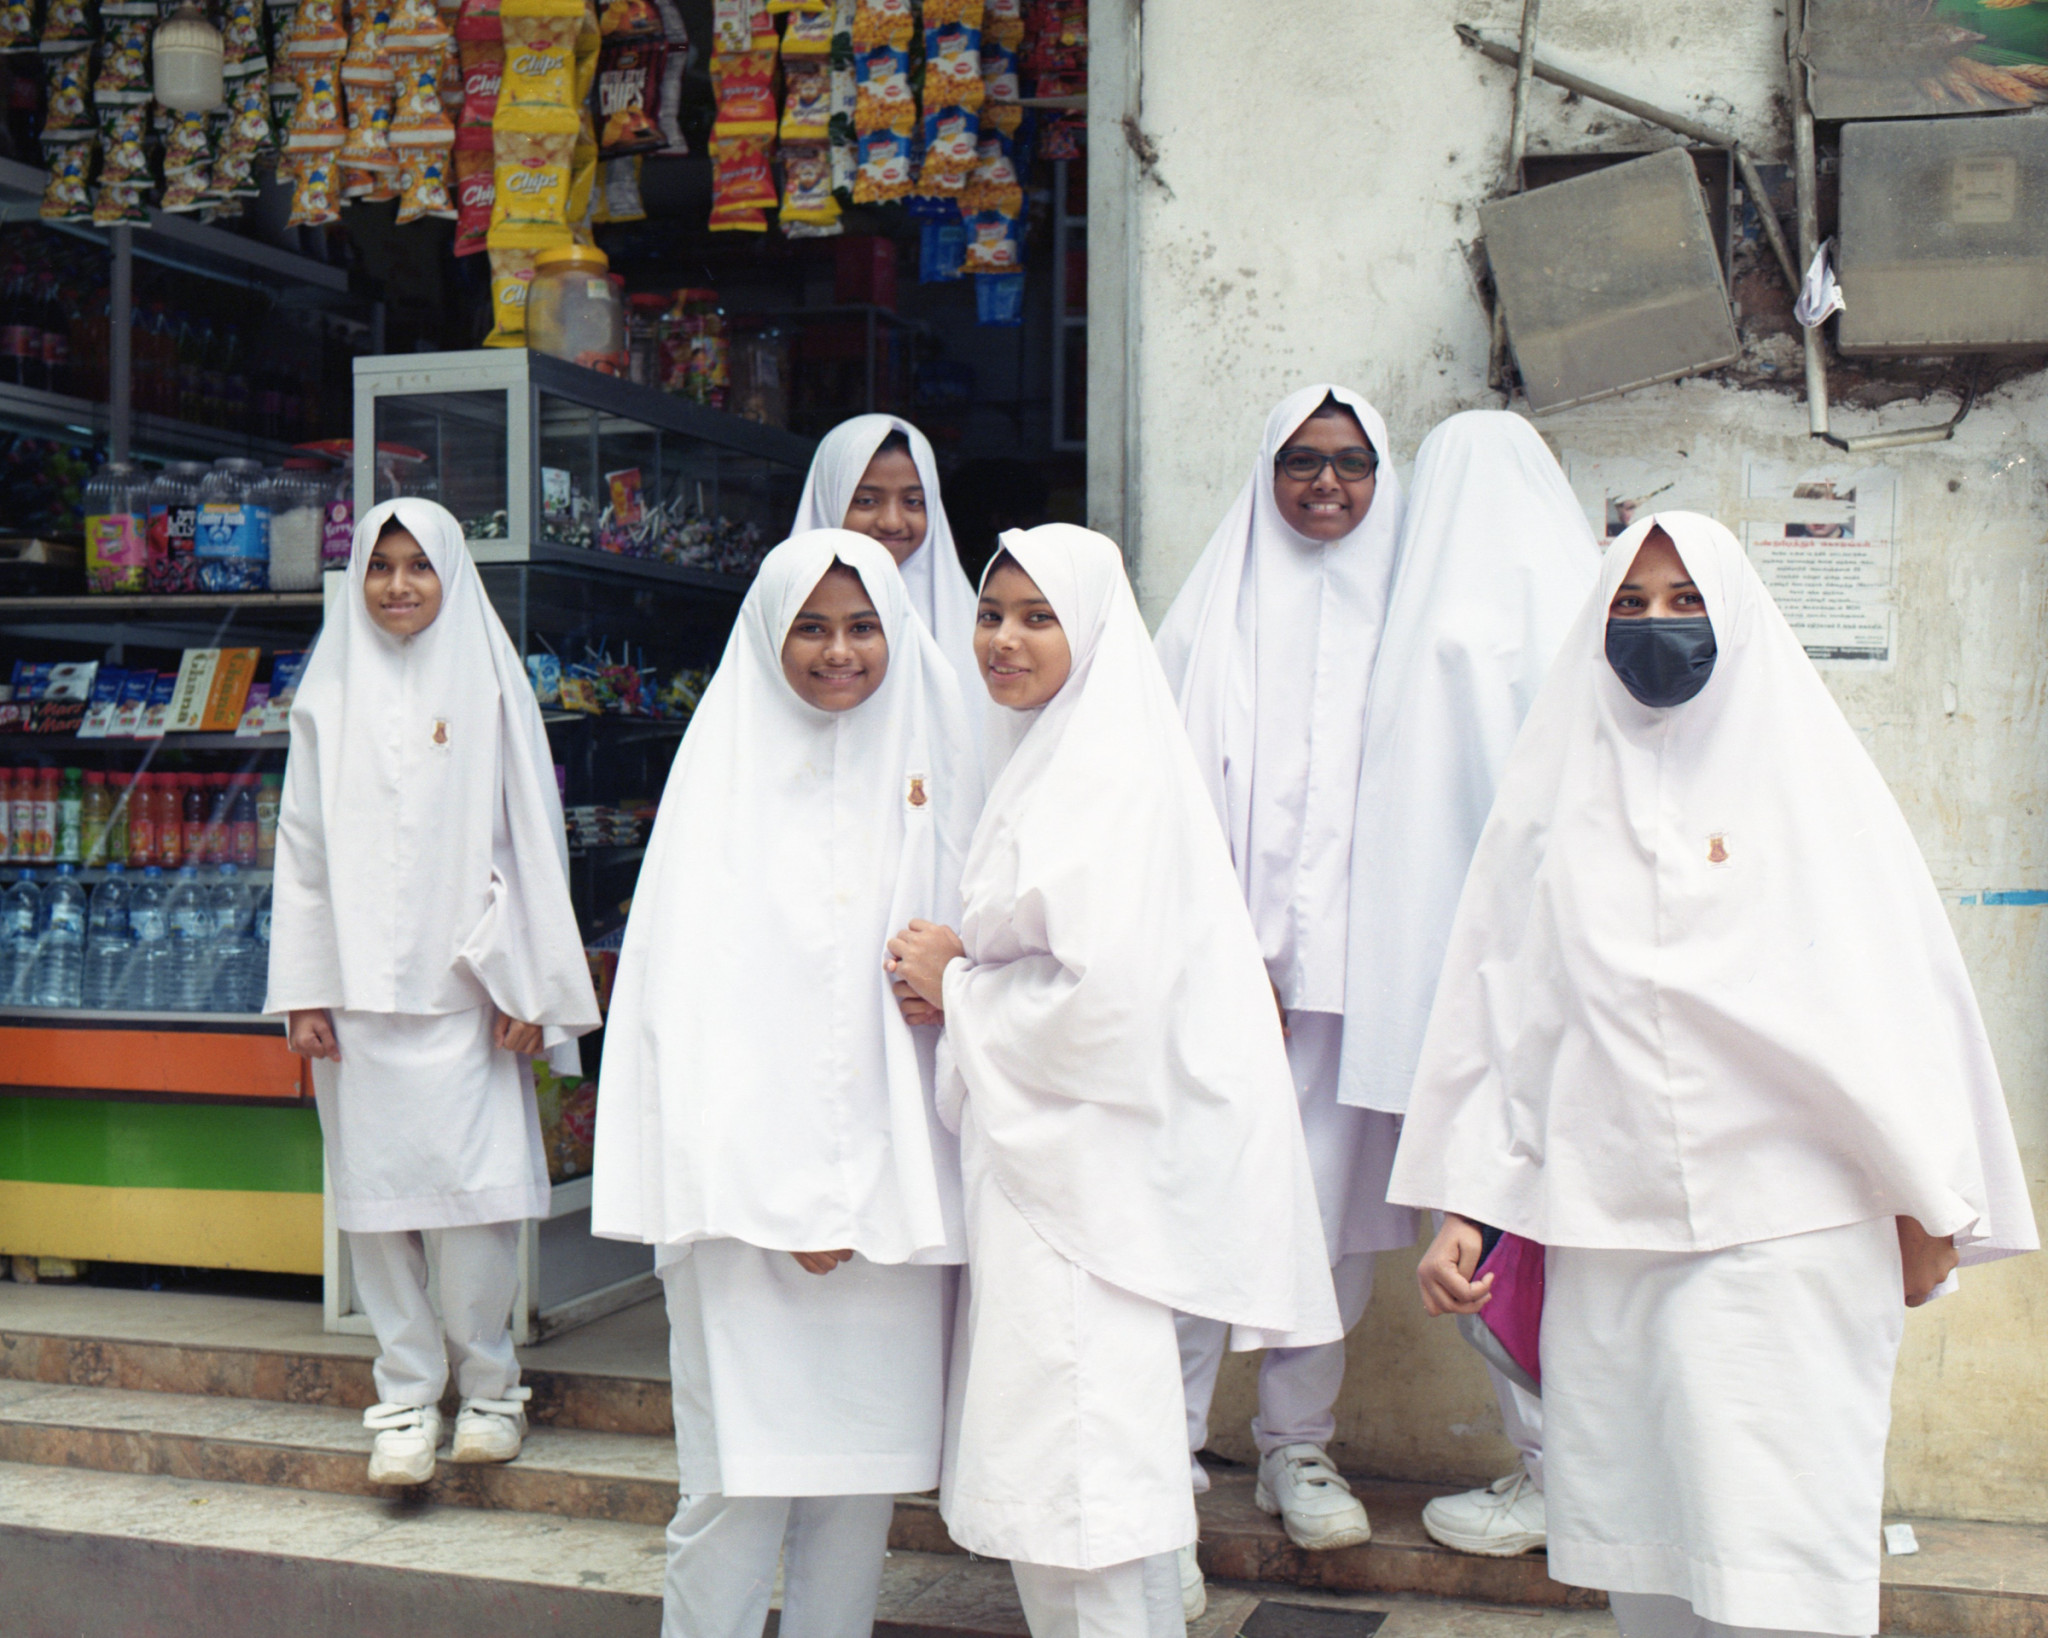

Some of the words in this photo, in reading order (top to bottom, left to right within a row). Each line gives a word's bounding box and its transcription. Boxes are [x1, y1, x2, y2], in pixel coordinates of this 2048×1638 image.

[512, 54, 564, 76] Chips
[466, 74, 501, 97] Chip
[599, 83, 644, 116] CHIPS
[505, 171, 558, 194] Chips
[462, 184, 496, 208] Chip
[177, 653, 208, 723] Ghana
[38, 701, 85, 717] Mars
[37, 717, 82, 734] Mars
